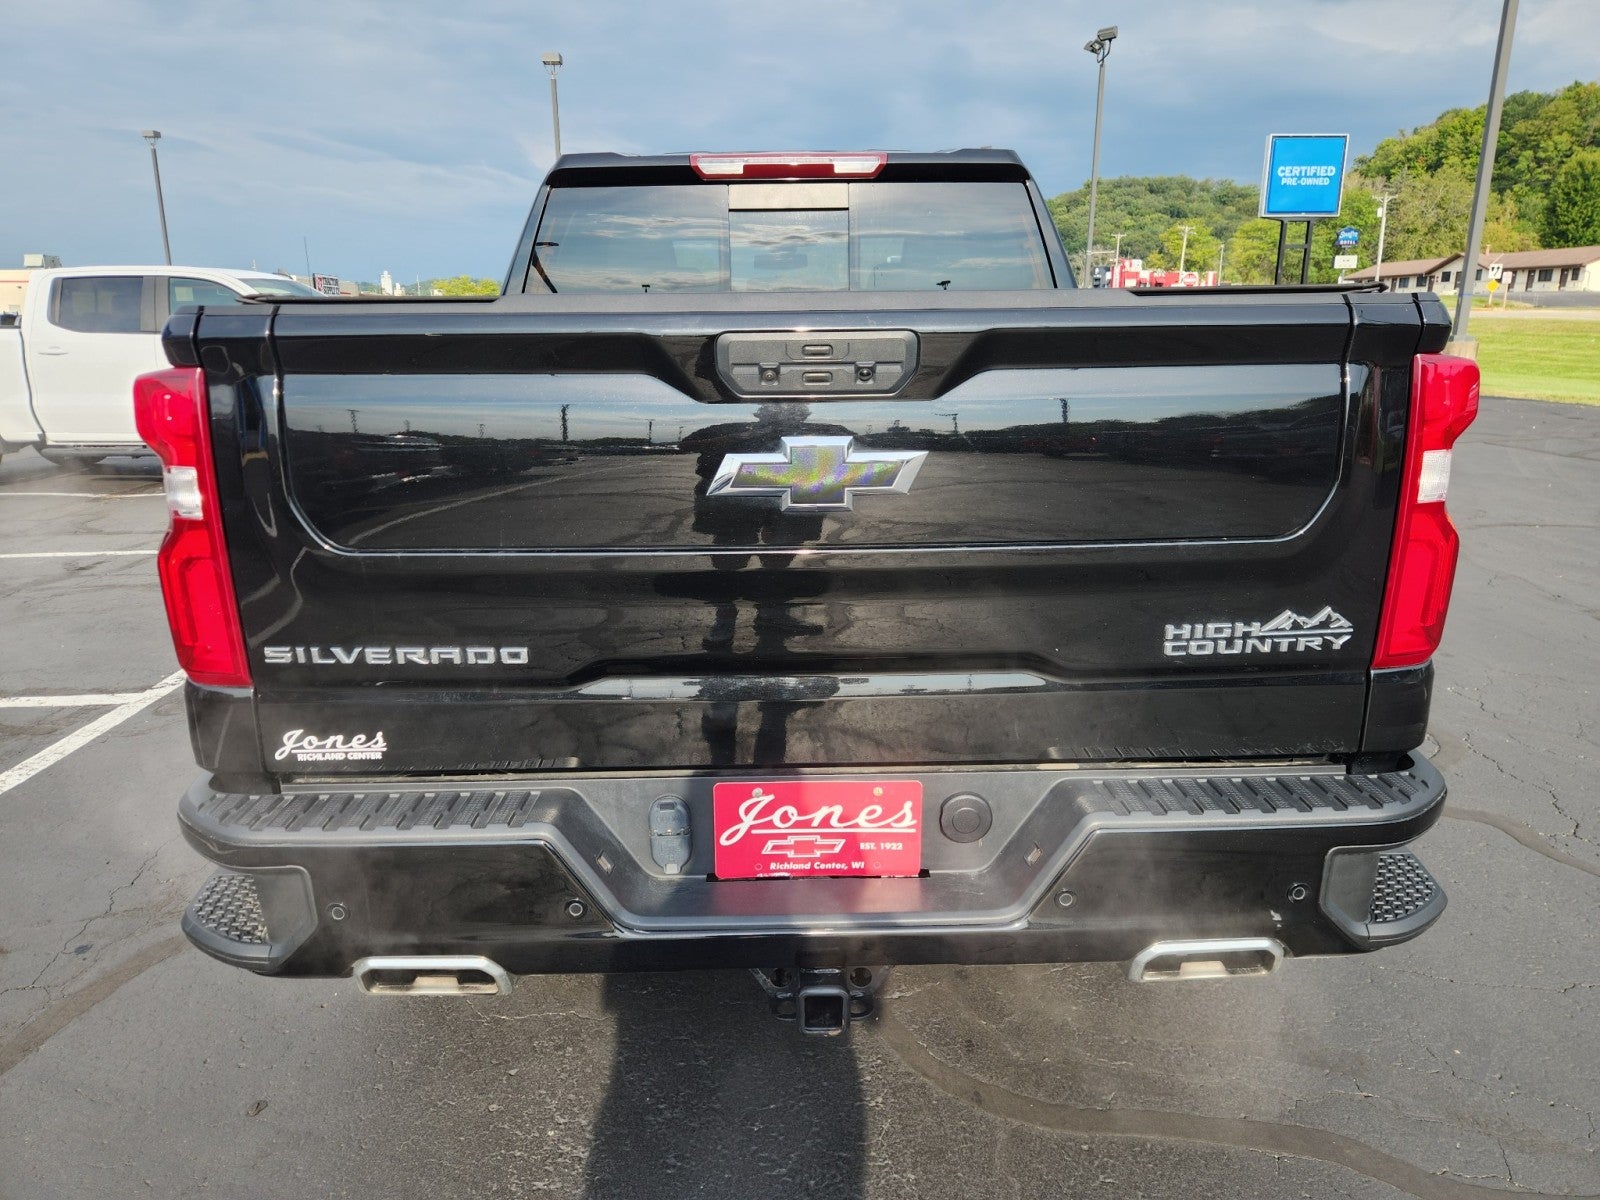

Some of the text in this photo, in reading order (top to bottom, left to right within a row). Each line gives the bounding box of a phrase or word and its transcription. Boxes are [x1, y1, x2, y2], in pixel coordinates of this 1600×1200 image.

[1277, 165, 1336, 177] CERTIFIED
[1281, 177, 1330, 186] PRE-OWNED
[1164, 621, 1261, 640] HIGH
[1163, 635, 1352, 656] COUNTRY
[263, 646, 529, 665] SILVERADO
[274, 729, 387, 761] Jones
[297, 752, 383, 762] RICHLAND CENTER
[719, 793, 918, 847] Jones
[859, 842, 903, 850] EST. 1922
[769, 860, 865, 871] Richland Center, WI
